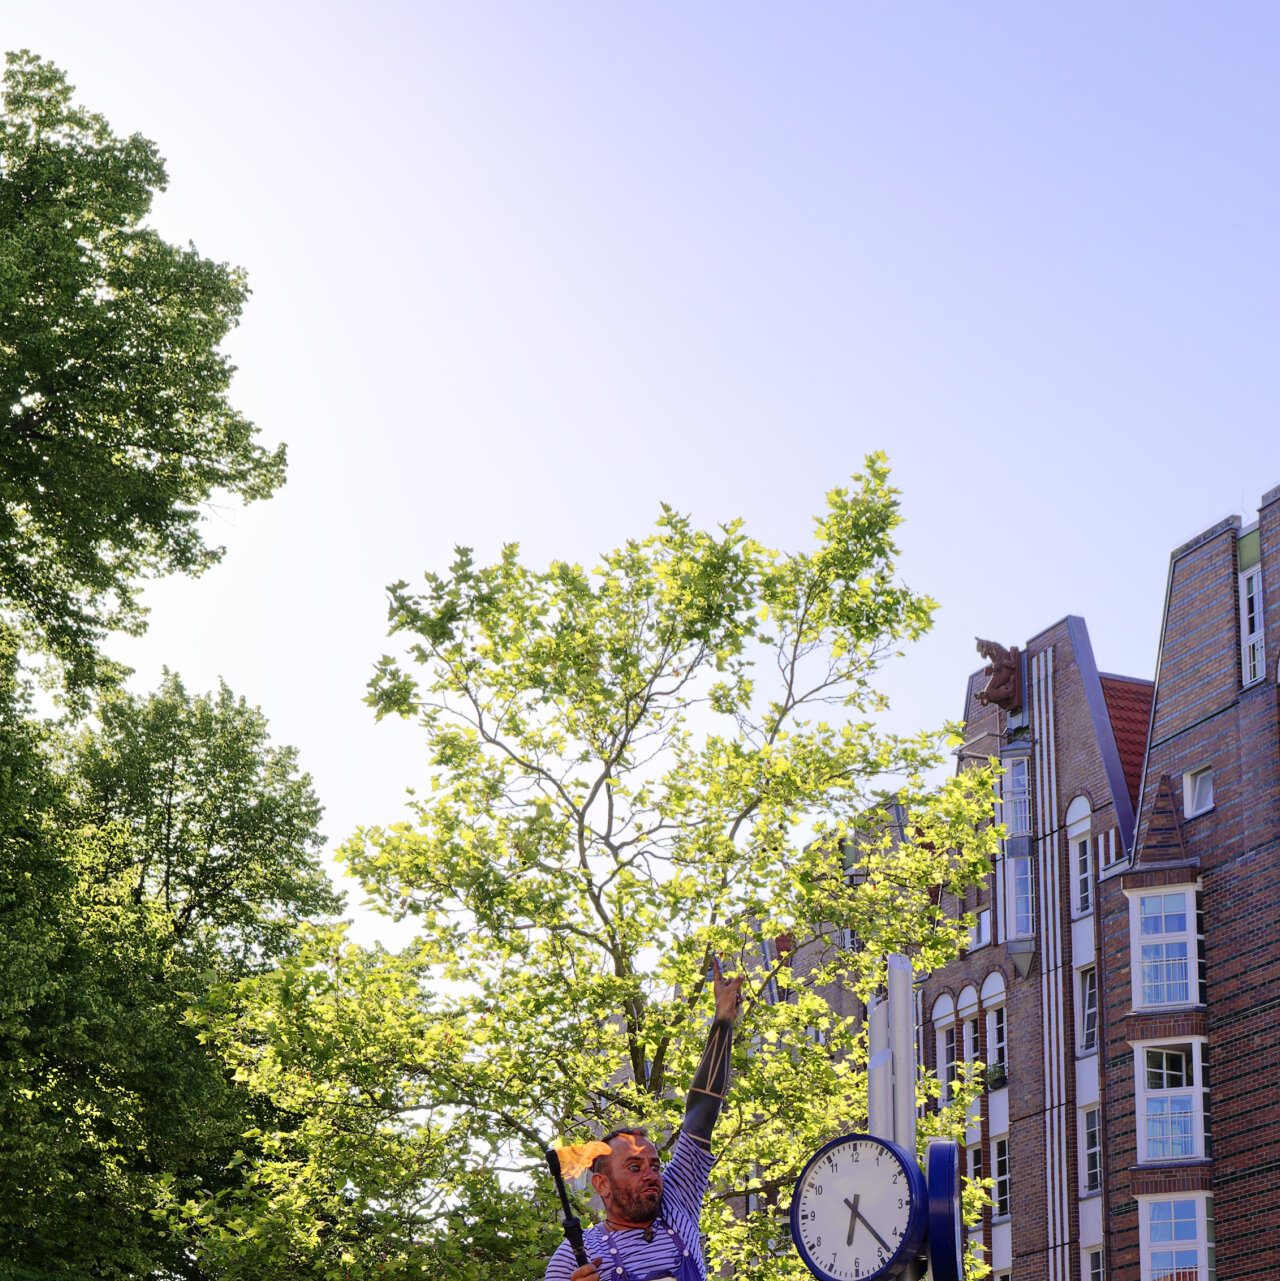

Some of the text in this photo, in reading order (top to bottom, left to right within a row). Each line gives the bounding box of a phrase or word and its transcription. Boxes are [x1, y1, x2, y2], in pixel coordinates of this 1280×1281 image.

[851, 1153, 860, 1163] 12
[875, 1157, 880, 1166] 1
[831, 1163, 838, 1173] 11
[892, 1175, 898, 1185] 2
[814, 1185, 823, 1195] 10
[898, 1199, 903, 1209] 3
[810, 1211, 815, 1221] 9
[891, 1227, 897, 1236] 4
[816, 1236, 822, 1246] 8
[877, 1248, 882, 1257] 5
[831, 1253, 837, 1263] 7
[854, 1258, 860, 1268] 6
